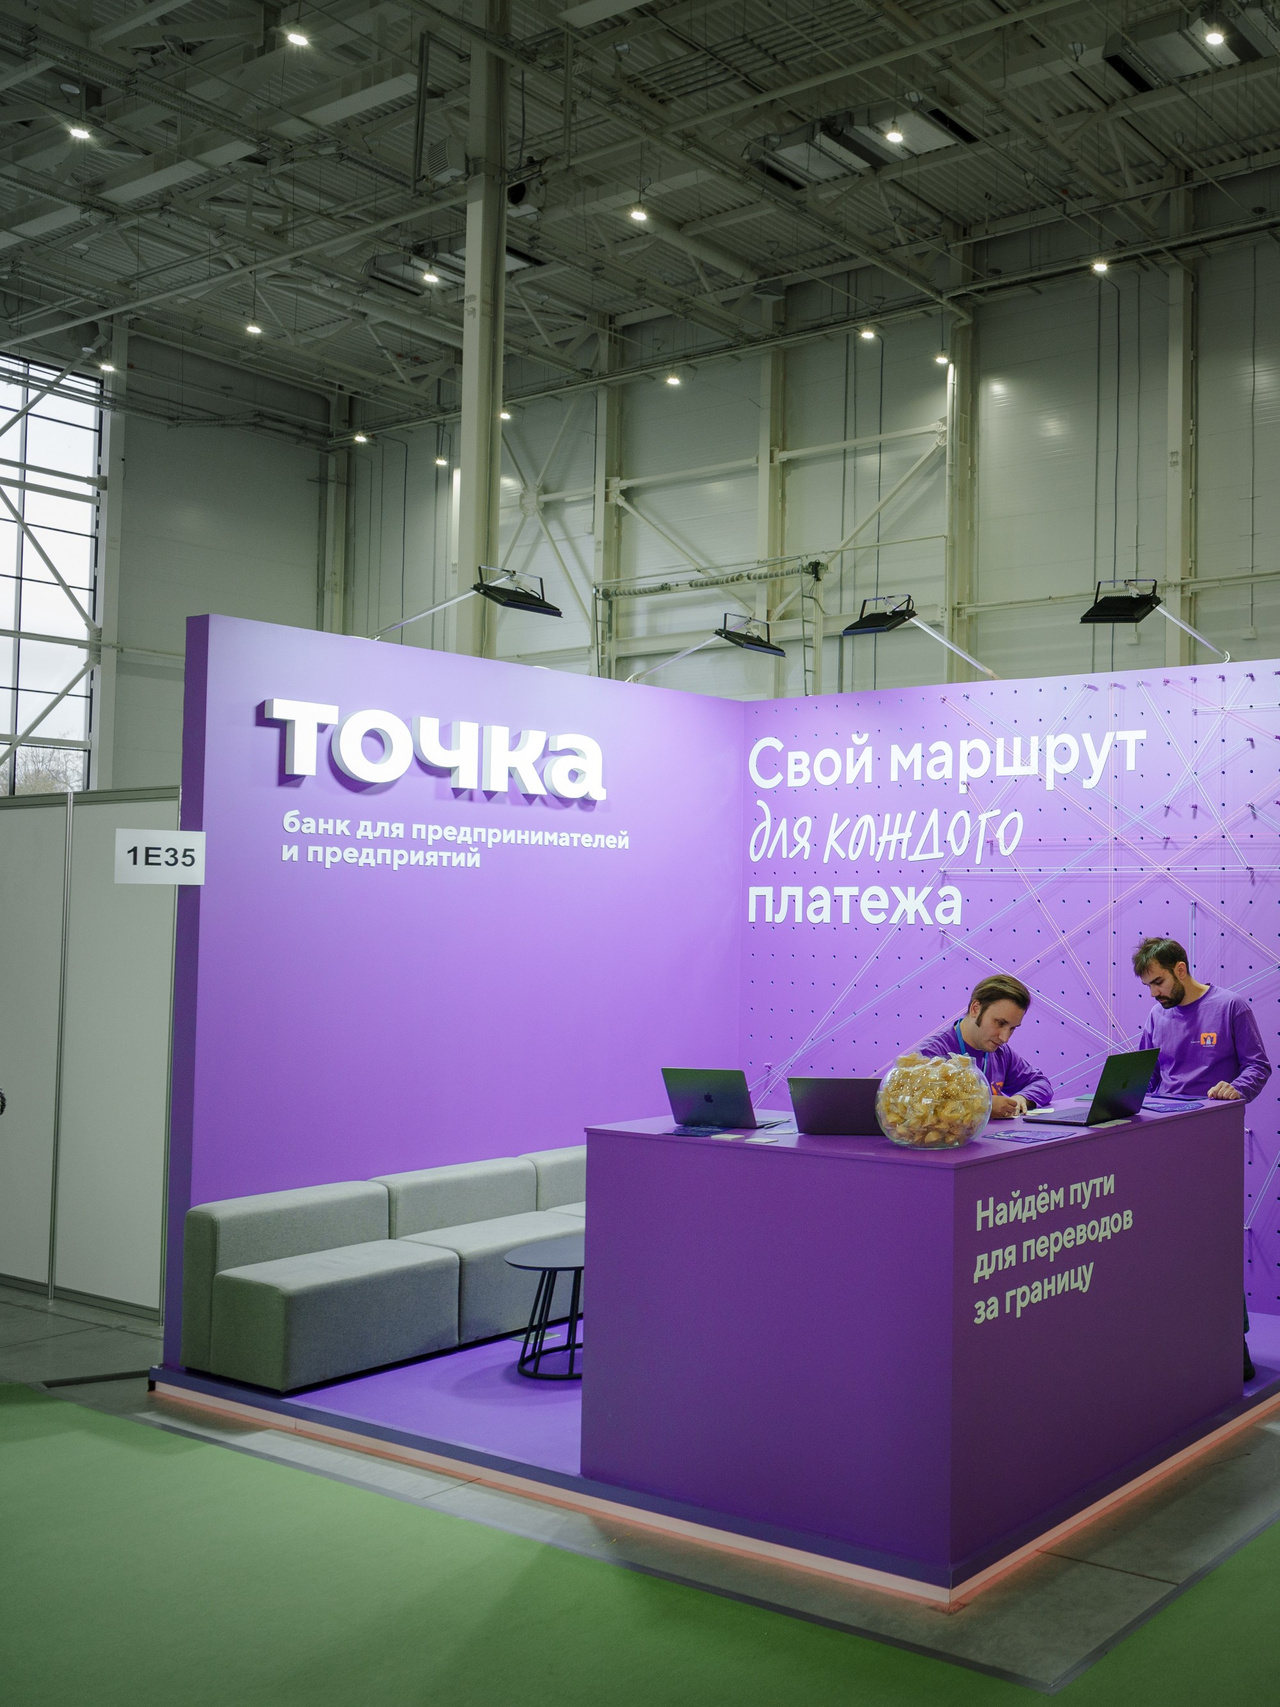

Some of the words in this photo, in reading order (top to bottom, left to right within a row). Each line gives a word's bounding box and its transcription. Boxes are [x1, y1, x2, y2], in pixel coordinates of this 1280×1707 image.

[263, 697, 607, 801] точка
[748, 732, 873, 789] Свой
[889, 729, 1147, 795] маршрут
[126, 845, 197, 868] 1E35
[281, 845, 299, 862] и
[306, 846, 482, 871] предприятий
[282, 809, 352, 837] банк
[356, 817, 405, 840] для
[411, 821, 630, 850] предпринимателей
[749, 799, 812, 864] для
[823, 807, 1025, 865] каждого
[748, 883, 963, 926] платежа
[975, 1184, 1065, 1232] Найдём
[1068, 1173, 1115, 1212] пути
[973, 1243, 1018, 1284] для
[1021, 1207, 1134, 1265] переводов
[973, 1291, 1000, 1325] за
[1005, 1261, 1095, 1319] границу
